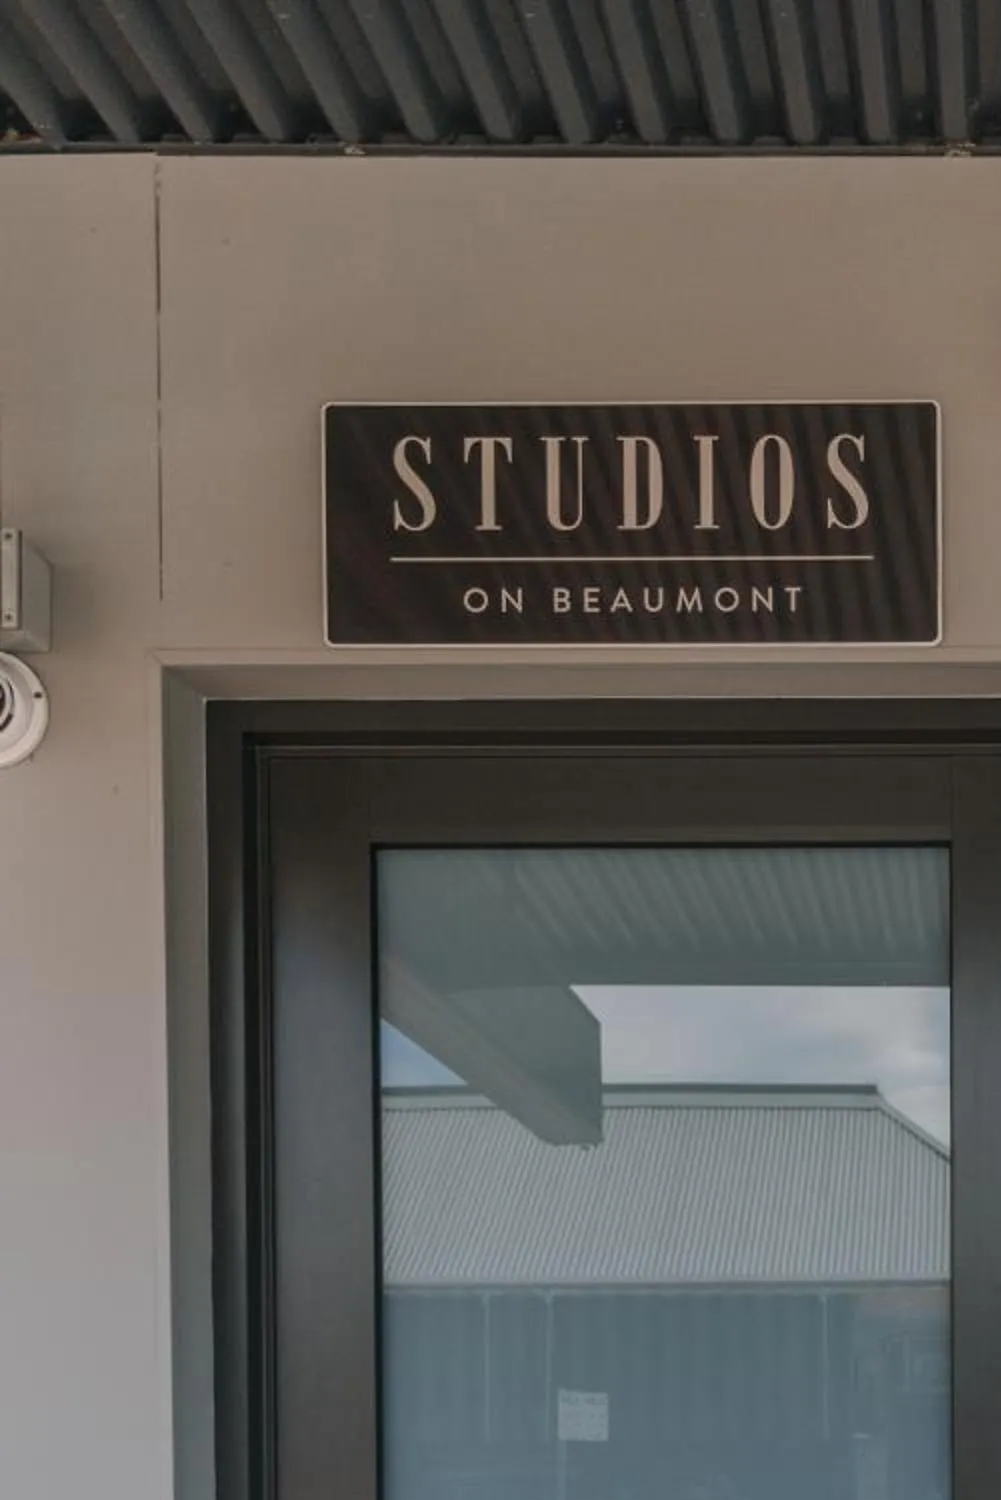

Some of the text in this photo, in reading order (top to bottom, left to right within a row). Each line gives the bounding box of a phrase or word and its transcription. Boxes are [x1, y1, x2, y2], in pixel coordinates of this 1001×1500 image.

[392, 433, 871, 533] STUDIOS
[463, 586, 804, 614] ON BEAUMONT
